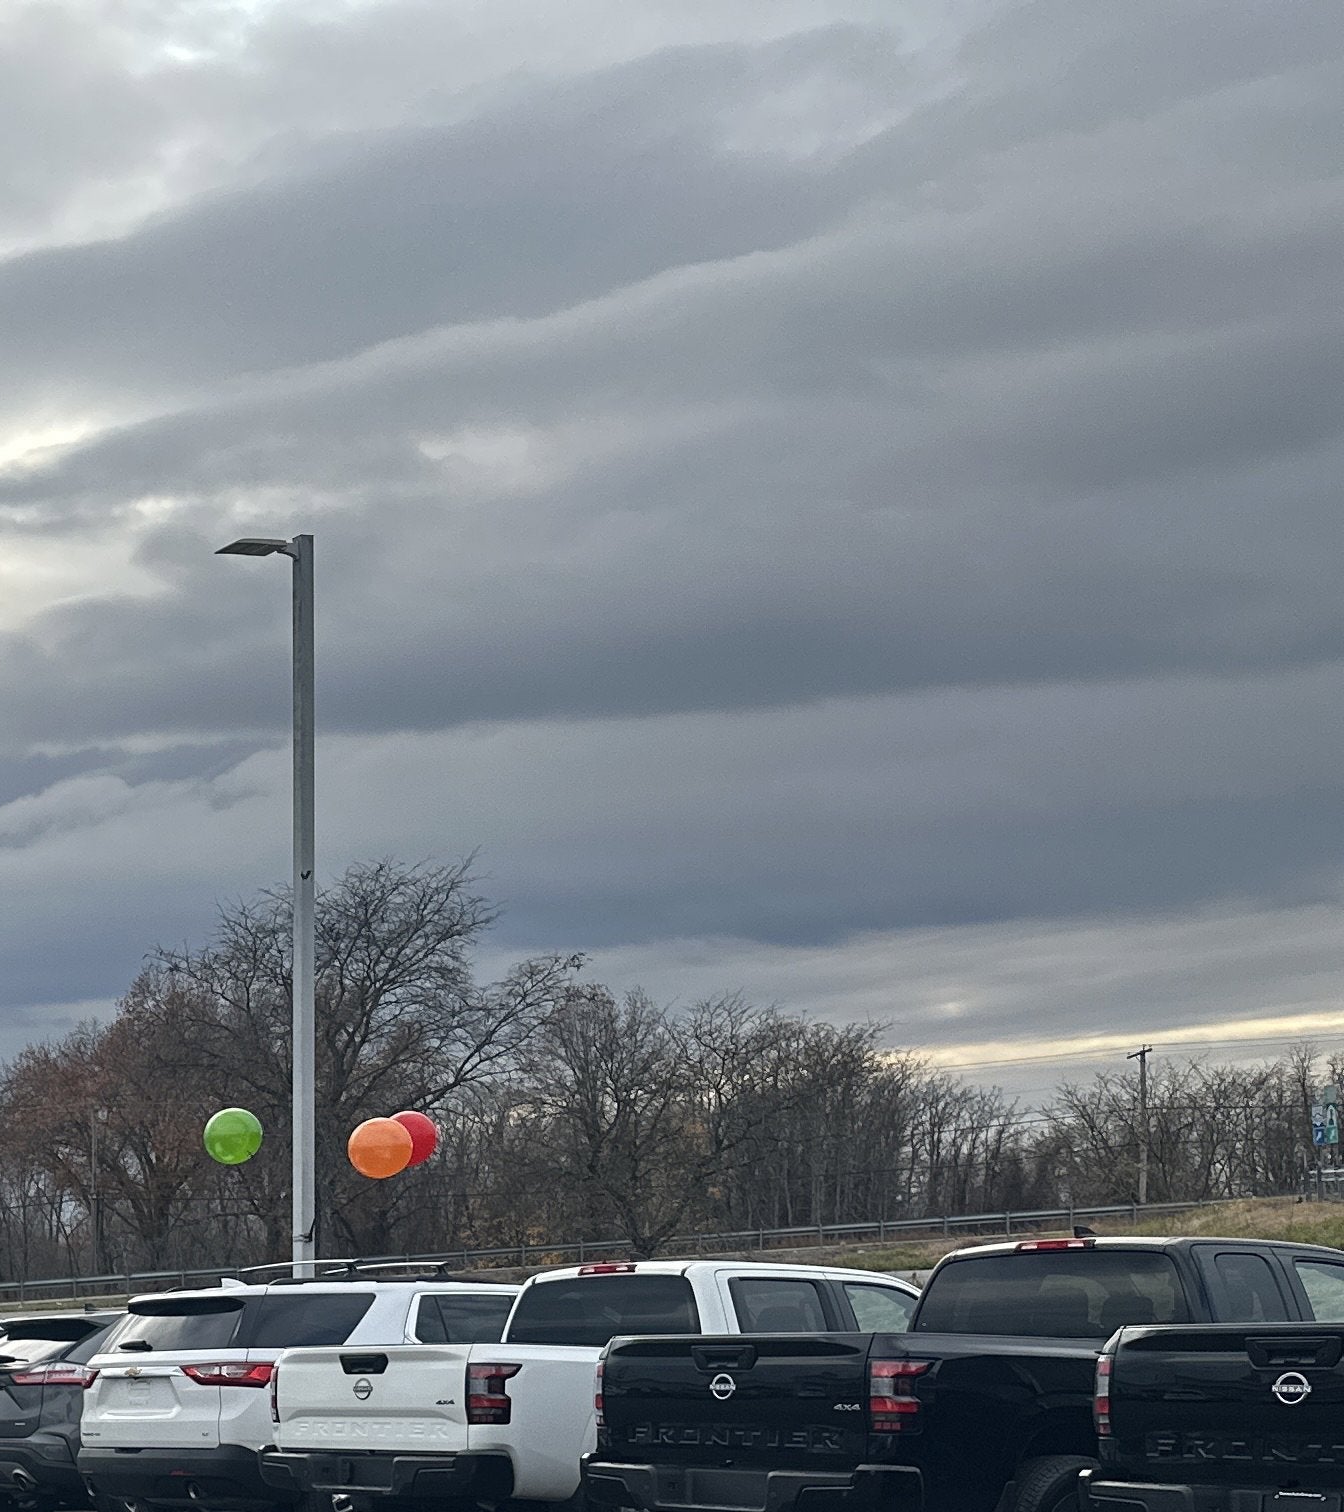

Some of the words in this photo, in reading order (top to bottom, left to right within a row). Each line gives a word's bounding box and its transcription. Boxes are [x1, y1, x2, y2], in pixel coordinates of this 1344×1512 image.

[1271, 1384, 1312, 1393] NISSAN
[293, 1420, 451, 1439] FRONTIER
[627, 1425, 842, 1449] FRONTIER
